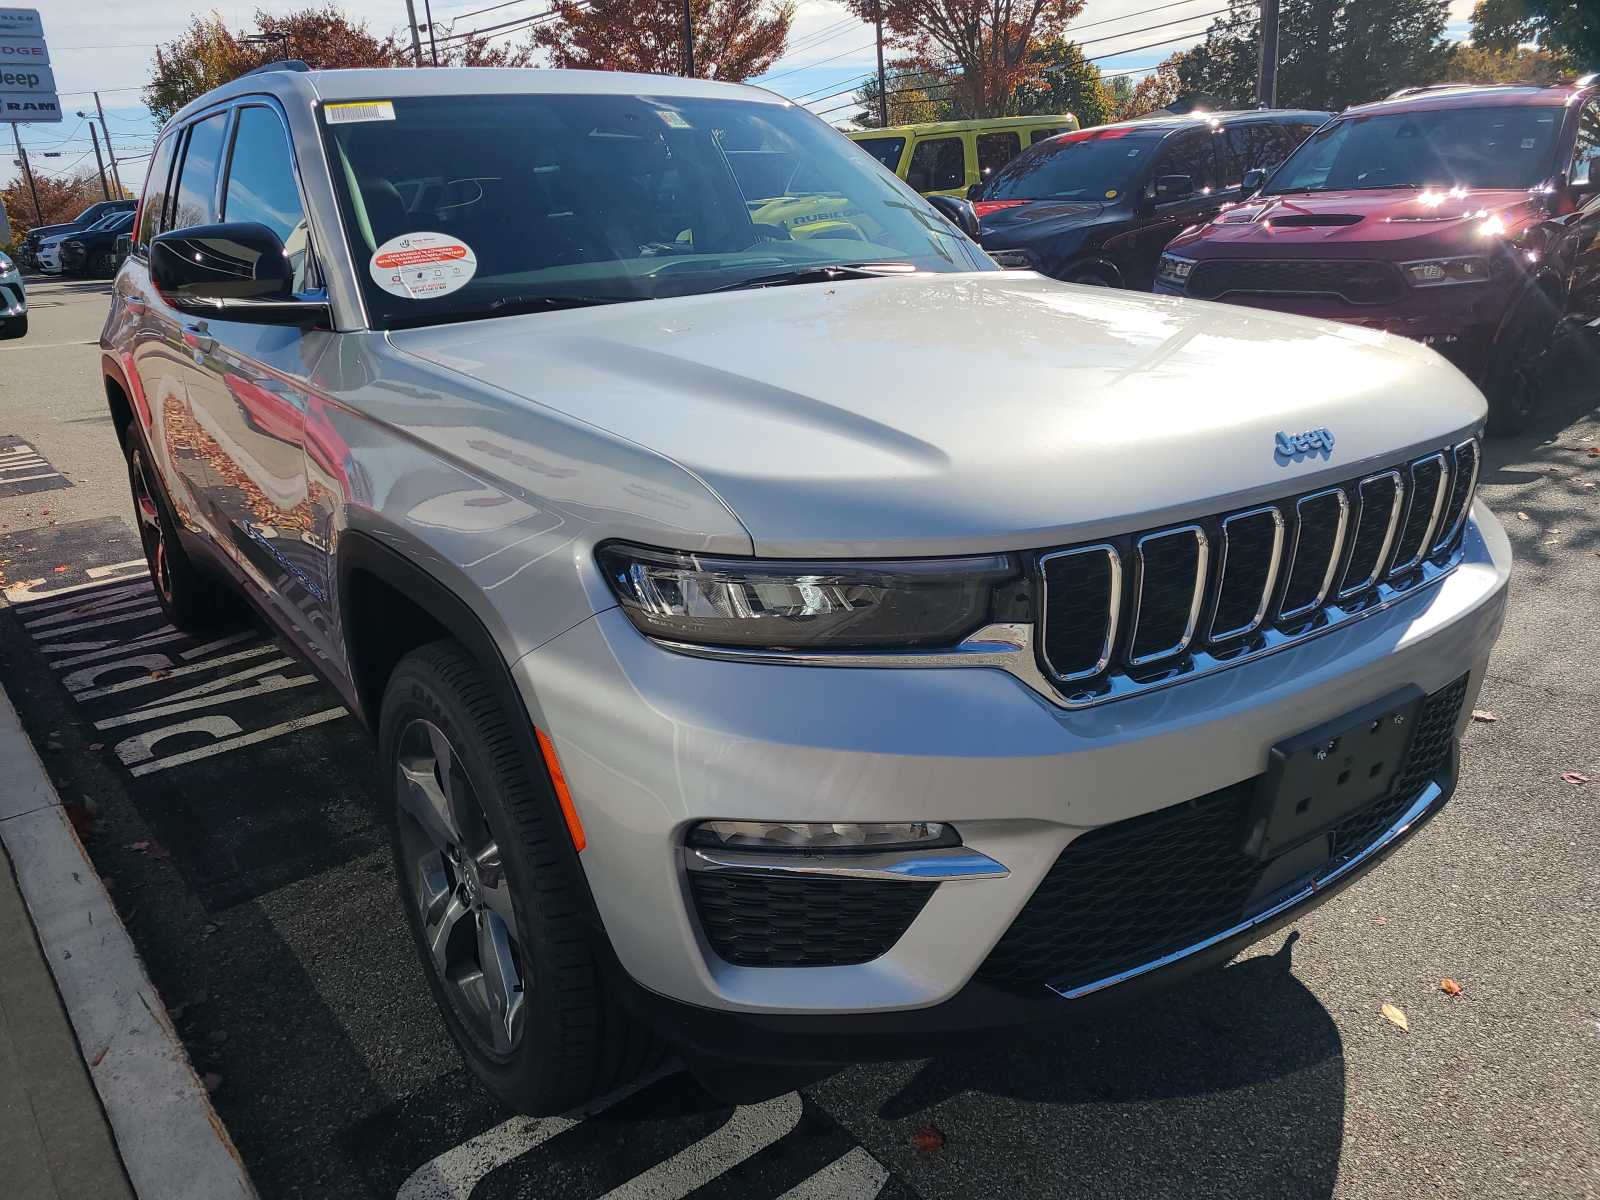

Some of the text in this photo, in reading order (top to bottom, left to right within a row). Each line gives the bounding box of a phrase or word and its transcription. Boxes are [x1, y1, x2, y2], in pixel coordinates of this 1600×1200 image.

[6, 102, 56, 111] RAM
[1274, 427, 1335, 457] Jeep
[2, 557, 350, 779] PARKING
